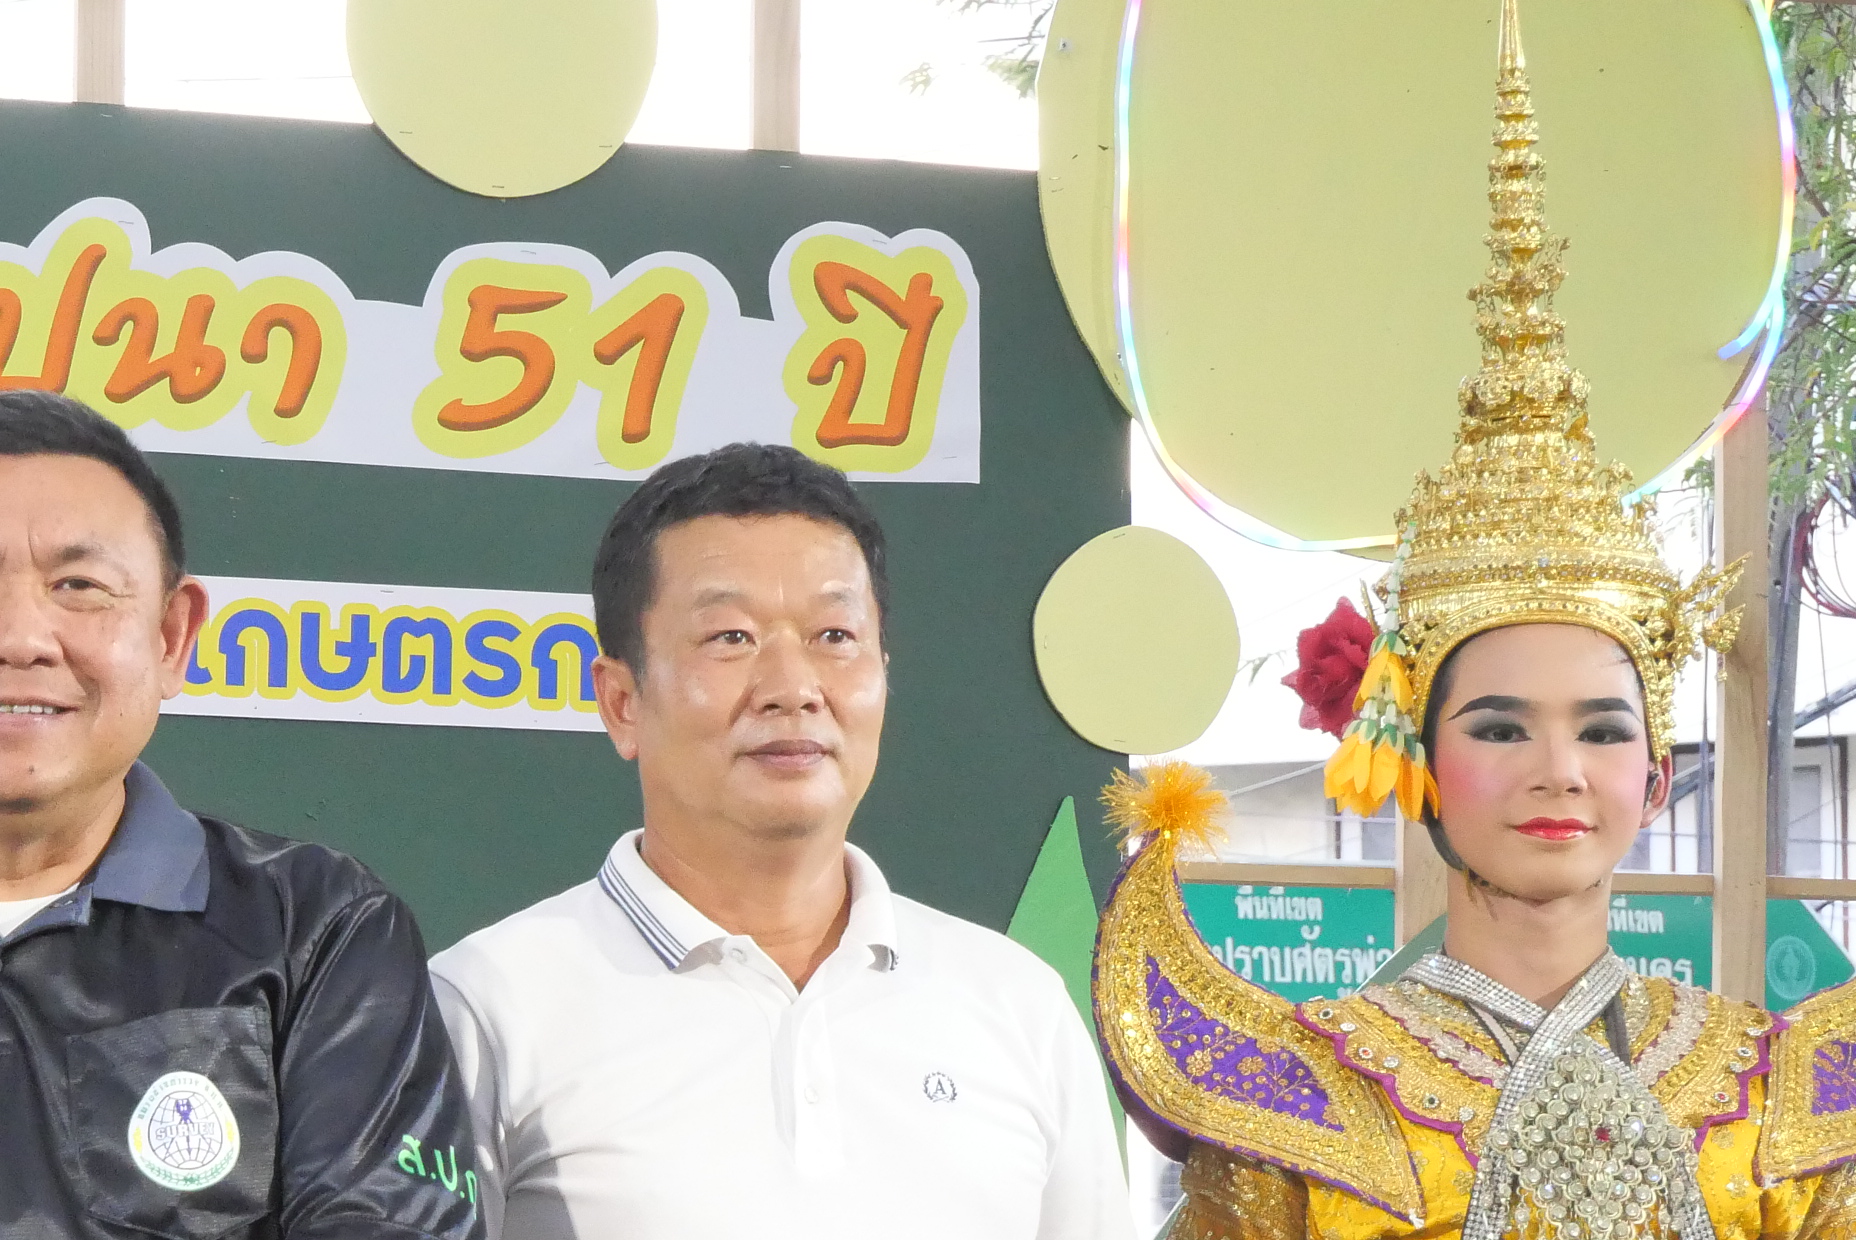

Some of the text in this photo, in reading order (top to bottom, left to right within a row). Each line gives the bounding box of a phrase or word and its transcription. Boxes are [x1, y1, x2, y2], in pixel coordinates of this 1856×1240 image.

[436, 284, 685, 445] 51
[806, 260, 944, 448] ปี
[155, 1121, 215, 1141] SURVEY
